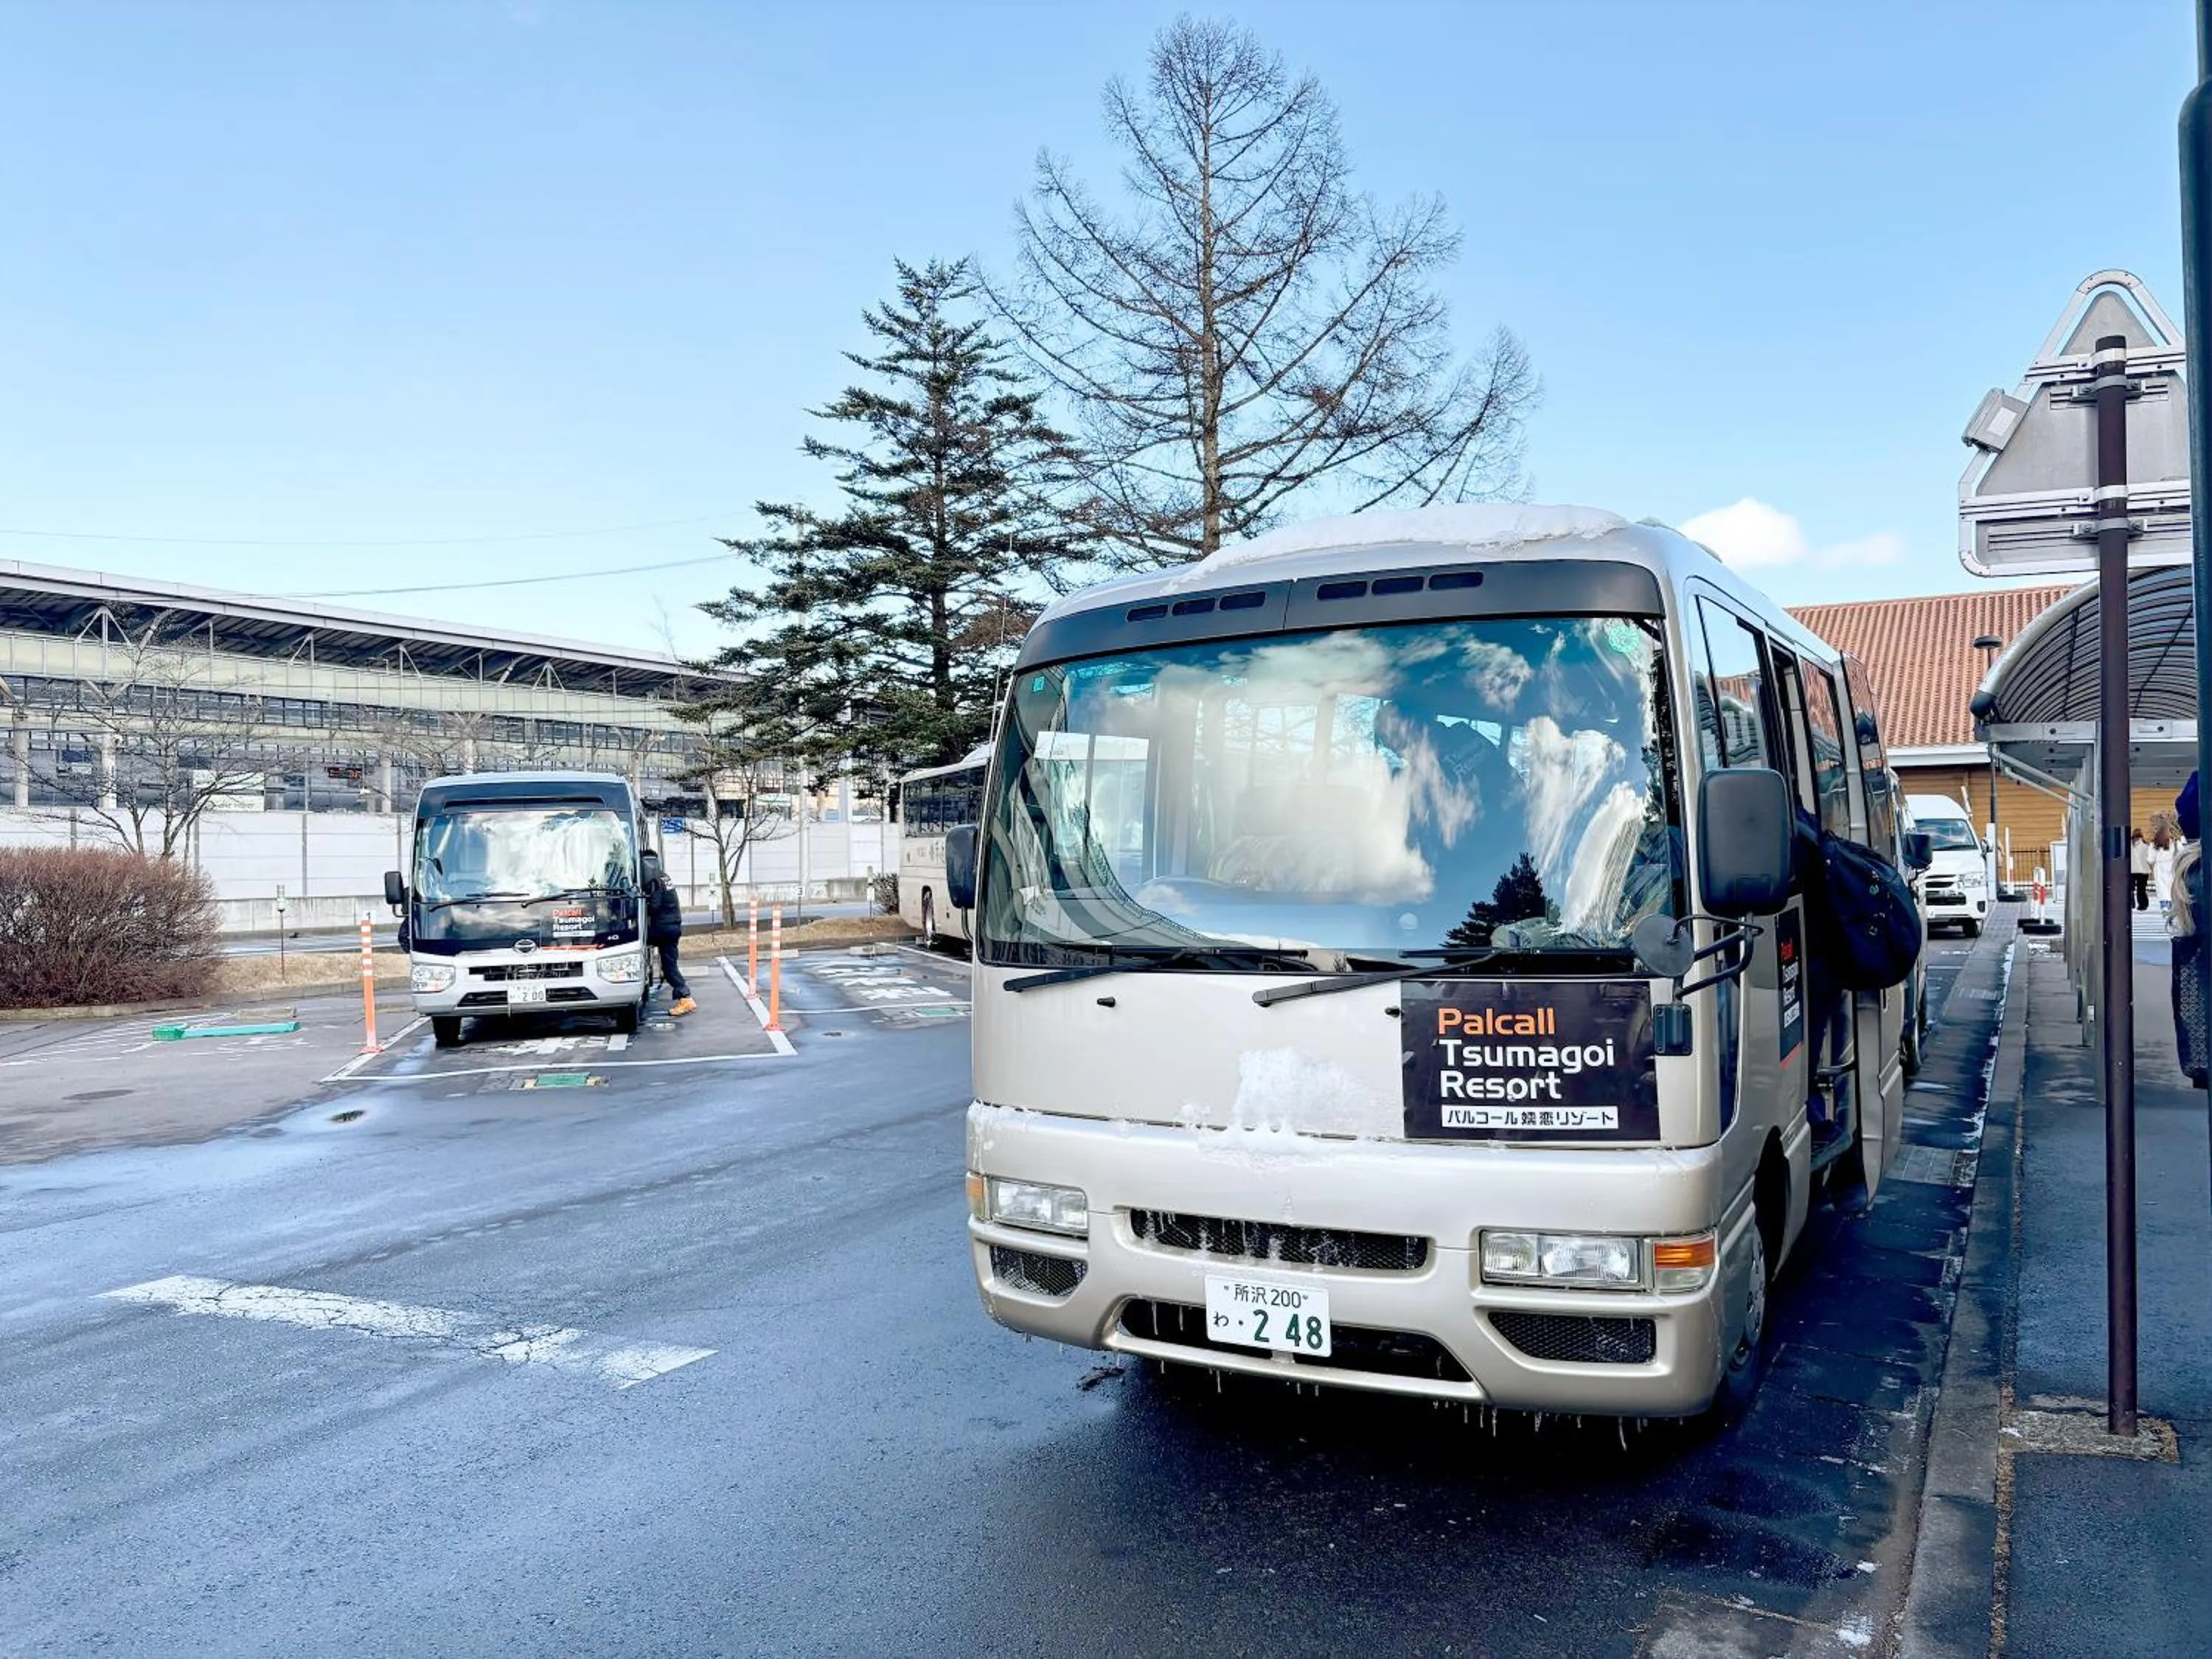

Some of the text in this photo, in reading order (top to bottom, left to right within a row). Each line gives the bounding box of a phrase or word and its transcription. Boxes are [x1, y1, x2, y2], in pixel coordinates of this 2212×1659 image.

[1438, 1007, 1555, 1035] Palcall
[1438, 1038, 1615, 1074] Tsumagoi
[1440, 1071, 1562, 1099] Resort
